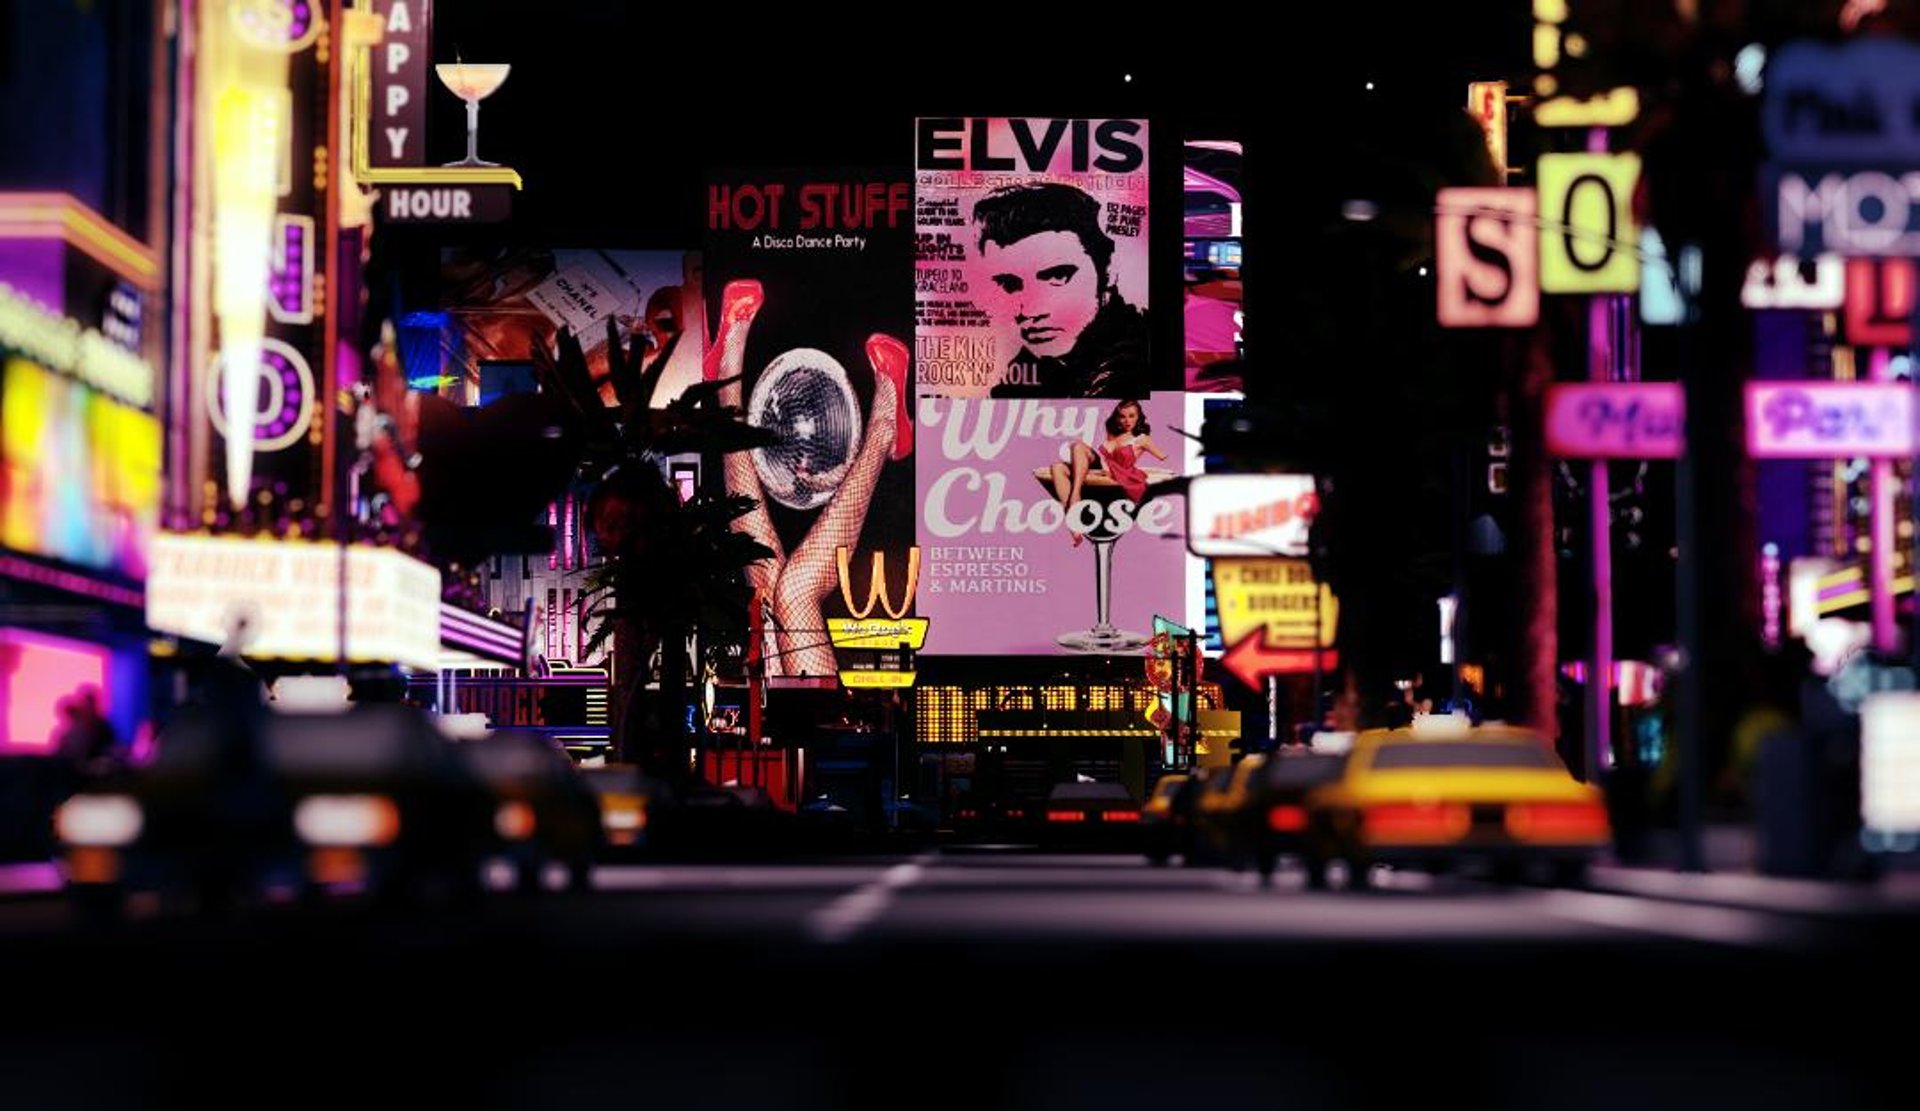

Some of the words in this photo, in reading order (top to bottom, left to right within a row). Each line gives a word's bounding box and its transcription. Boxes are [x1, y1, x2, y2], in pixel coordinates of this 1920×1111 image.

[917, 119, 1144, 173] ELVIS
[390, 189, 472, 218] HOUR
[709, 183, 784, 230] HOT
[800, 182, 909, 229] STUFF
[1121, 204, 1146, 217] PAGES
[1107, 213, 1119, 223] OF
[1778, 171, 1920, 252] MO
[1106, 224, 1140, 237] PRESLEY
[752, 235, 761, 248] A
[764, 235, 794, 248] Disco
[796, 235, 833, 248] Dance
[835, 234, 867, 250] Party
[916, 233, 933, 244] UP
[936, 233, 951, 244] IN
[916, 244, 965, 255] LIGHTS
[917, 269, 948, 282] TUPELO
[951, 269, 962, 282] TO
[916, 281, 969, 294] GRACELAND
[556, 278, 598, 319] CHANEL
[916, 336, 950, 360] THE
[919, 399, 1100, 463] Why
[924, 467, 1175, 538] Choose
[930, 547, 1024, 561] BETWEEN
[930, 563, 1029, 577] ESPRESSO
[929, 579, 943, 593] &
[950, 579, 1047, 594] MARTINIS
